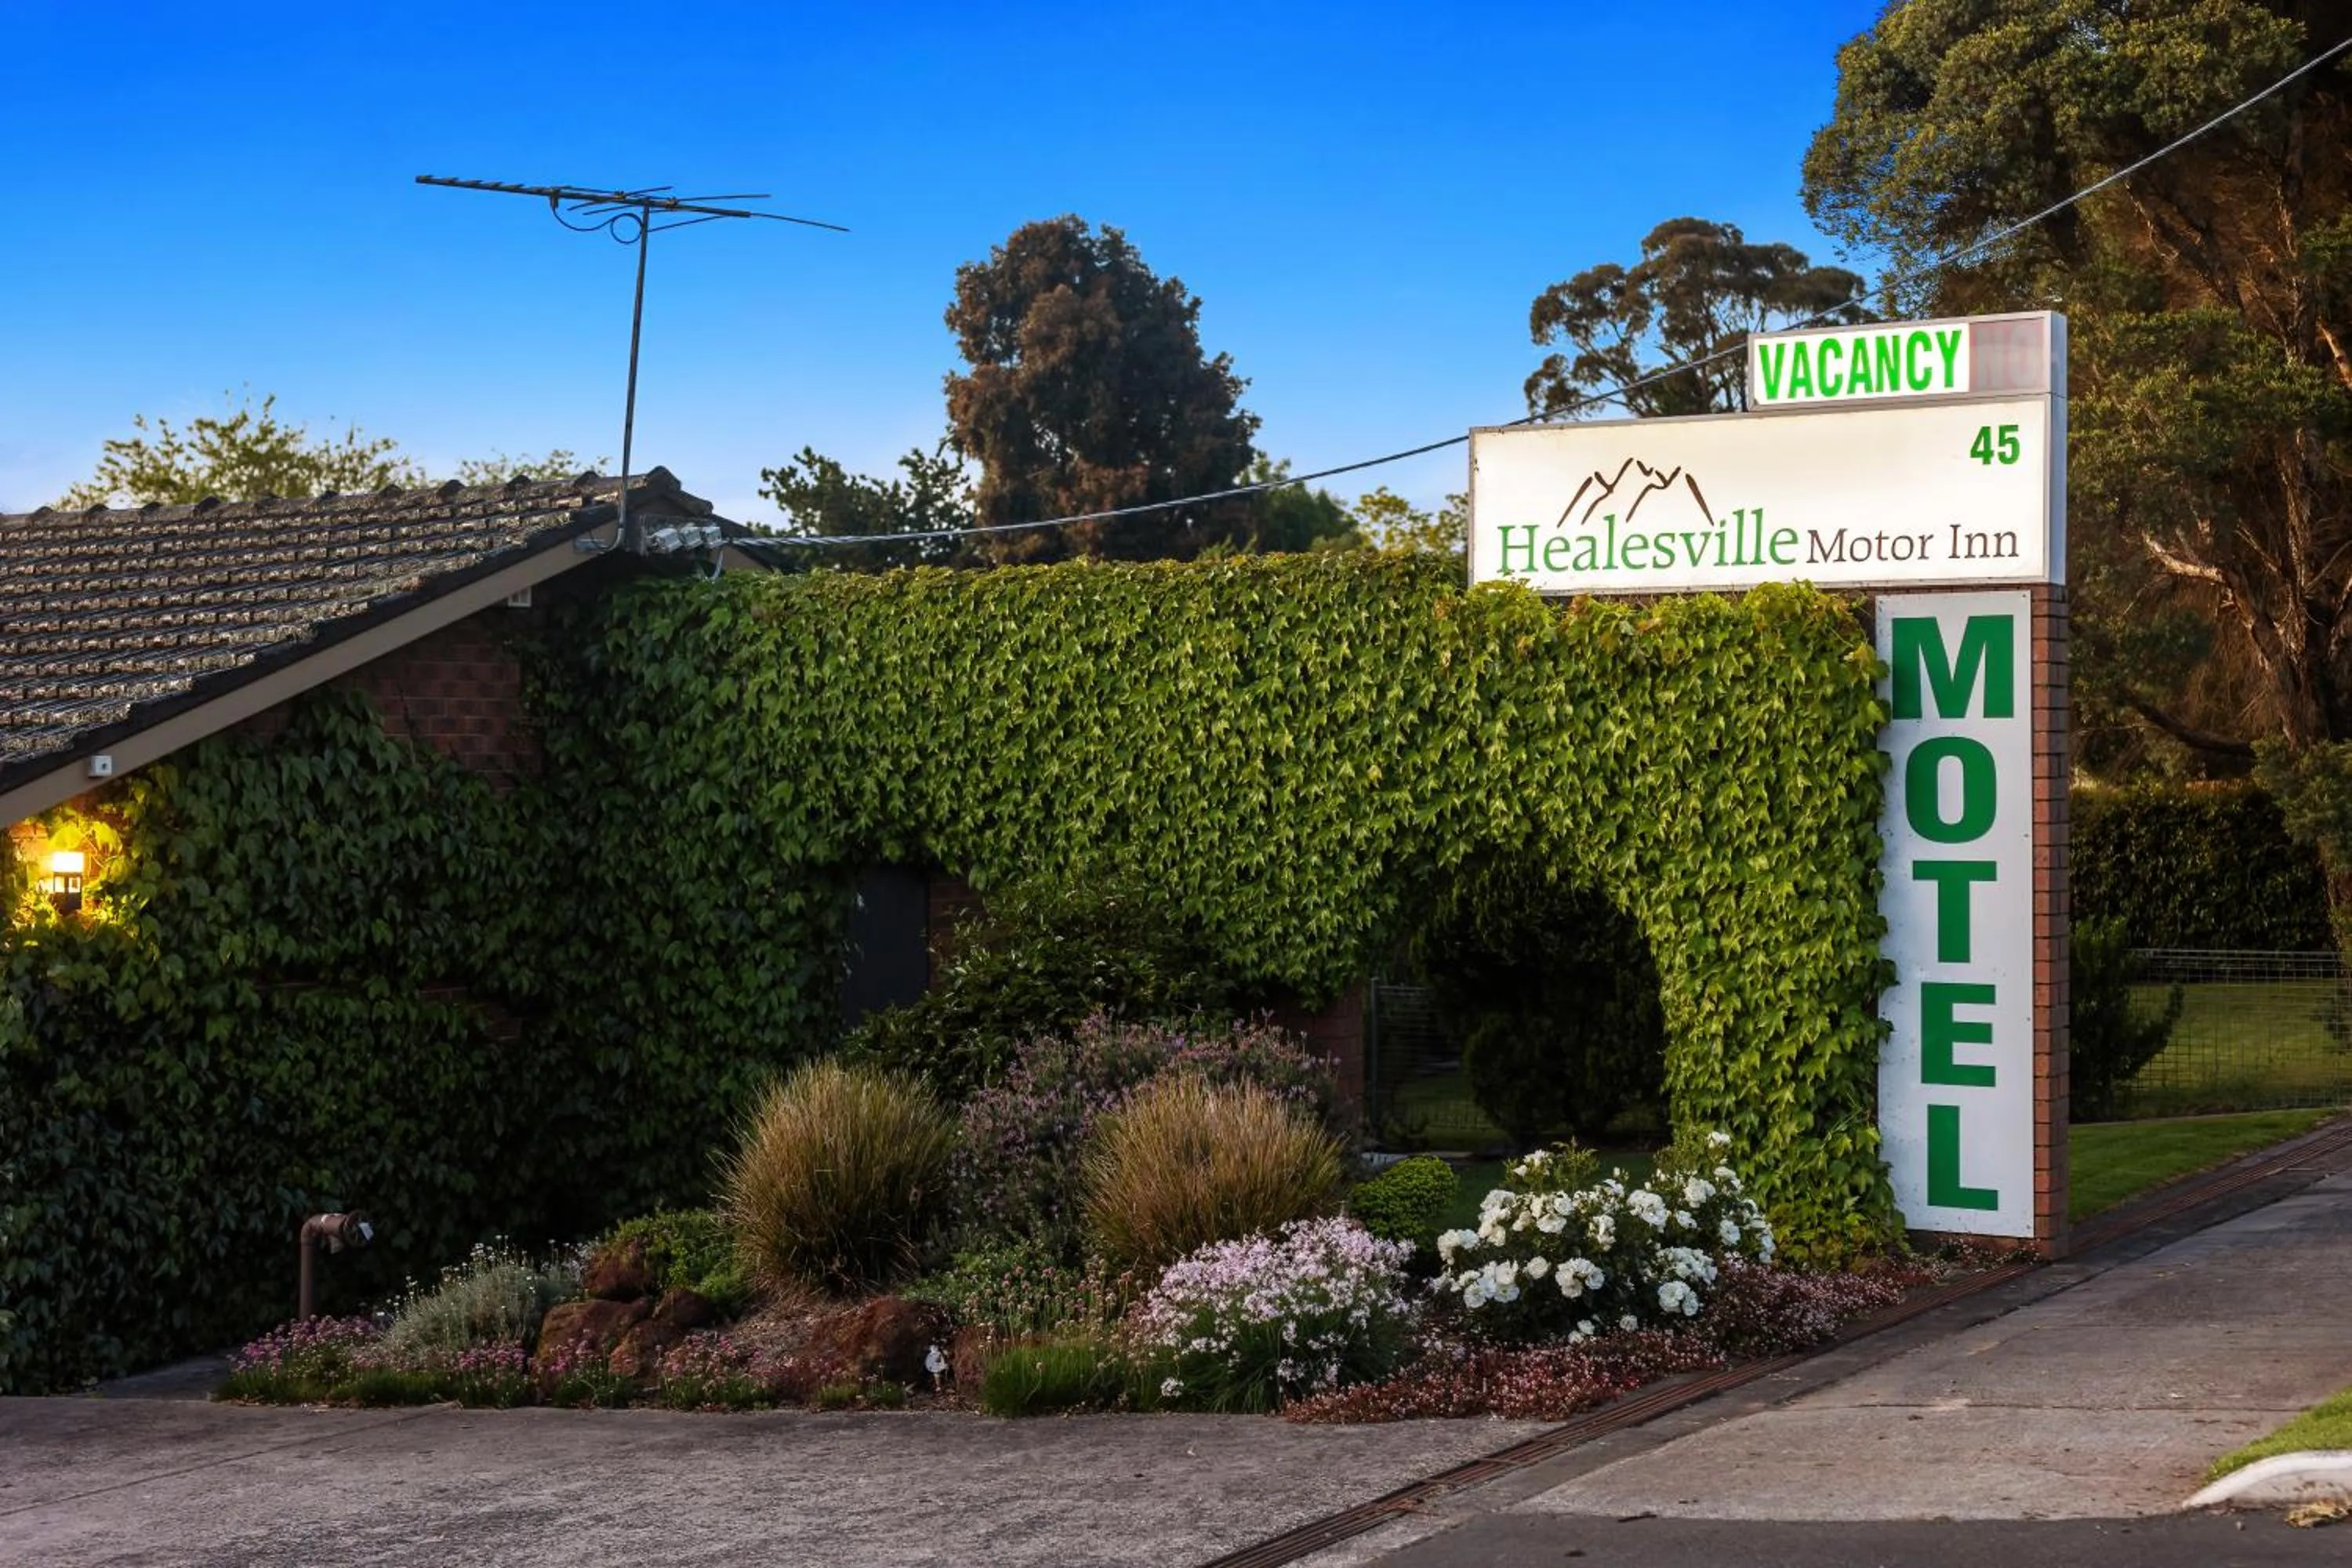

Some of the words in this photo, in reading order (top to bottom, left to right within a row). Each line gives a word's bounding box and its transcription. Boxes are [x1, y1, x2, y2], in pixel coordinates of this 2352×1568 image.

[1758, 327, 1964, 401] VACANCY
[1969, 424, 2021, 466] 45
[1497, 508, 1798, 574] Healesville
[1806, 528, 1934, 564] Motor
[1947, 524, 2020, 559] Inn
[1892, 614, 2014, 1210] MOTEL
